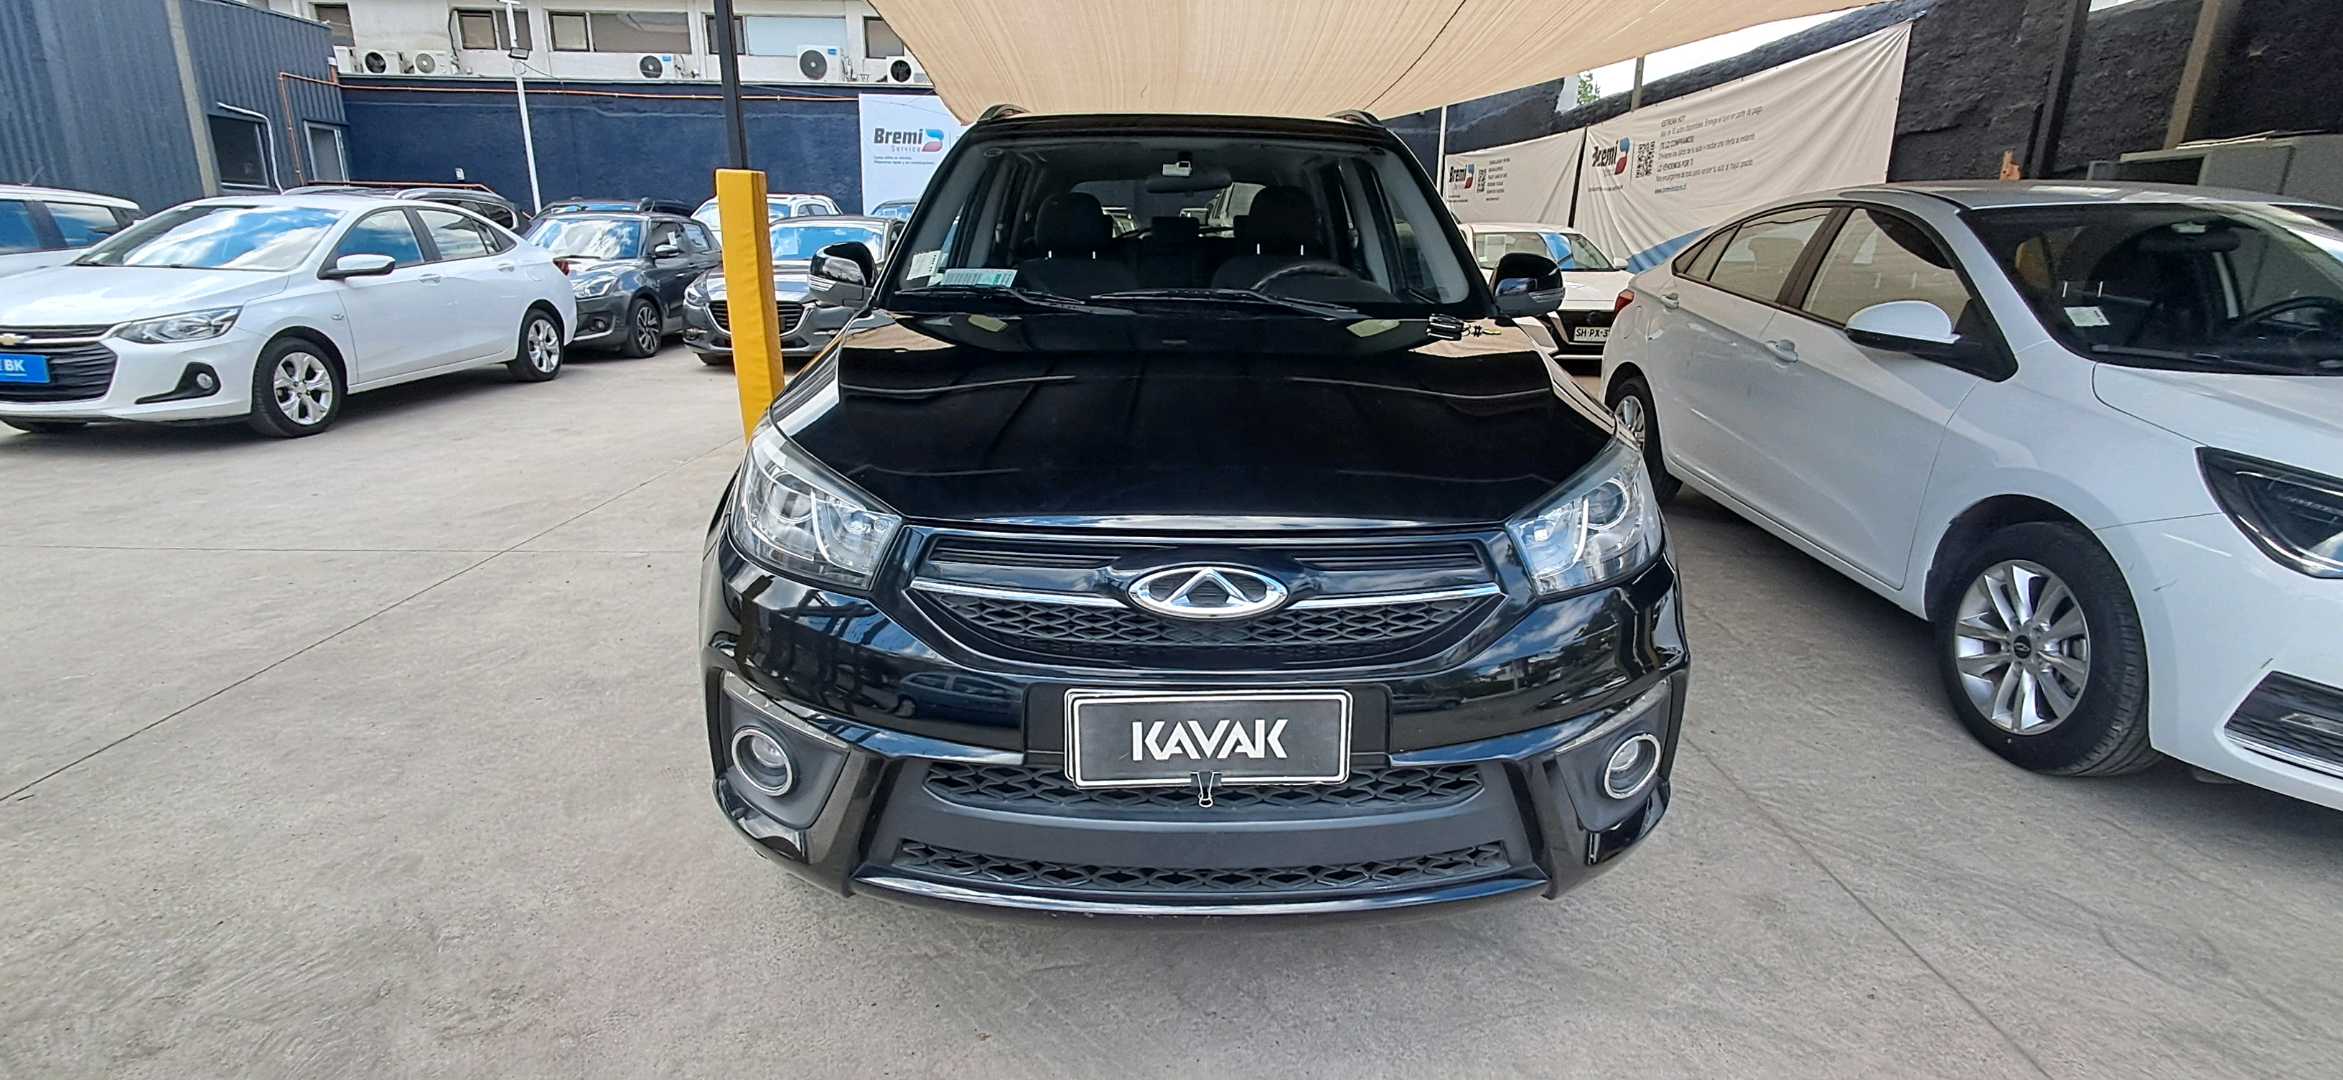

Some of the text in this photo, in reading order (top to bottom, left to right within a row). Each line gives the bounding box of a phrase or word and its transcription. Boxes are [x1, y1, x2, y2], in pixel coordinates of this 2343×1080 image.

[874, 128, 923, 144] Bremi
[4, 359, 26, 371] BK
[1132, 719, 1288, 761] KAVAK
